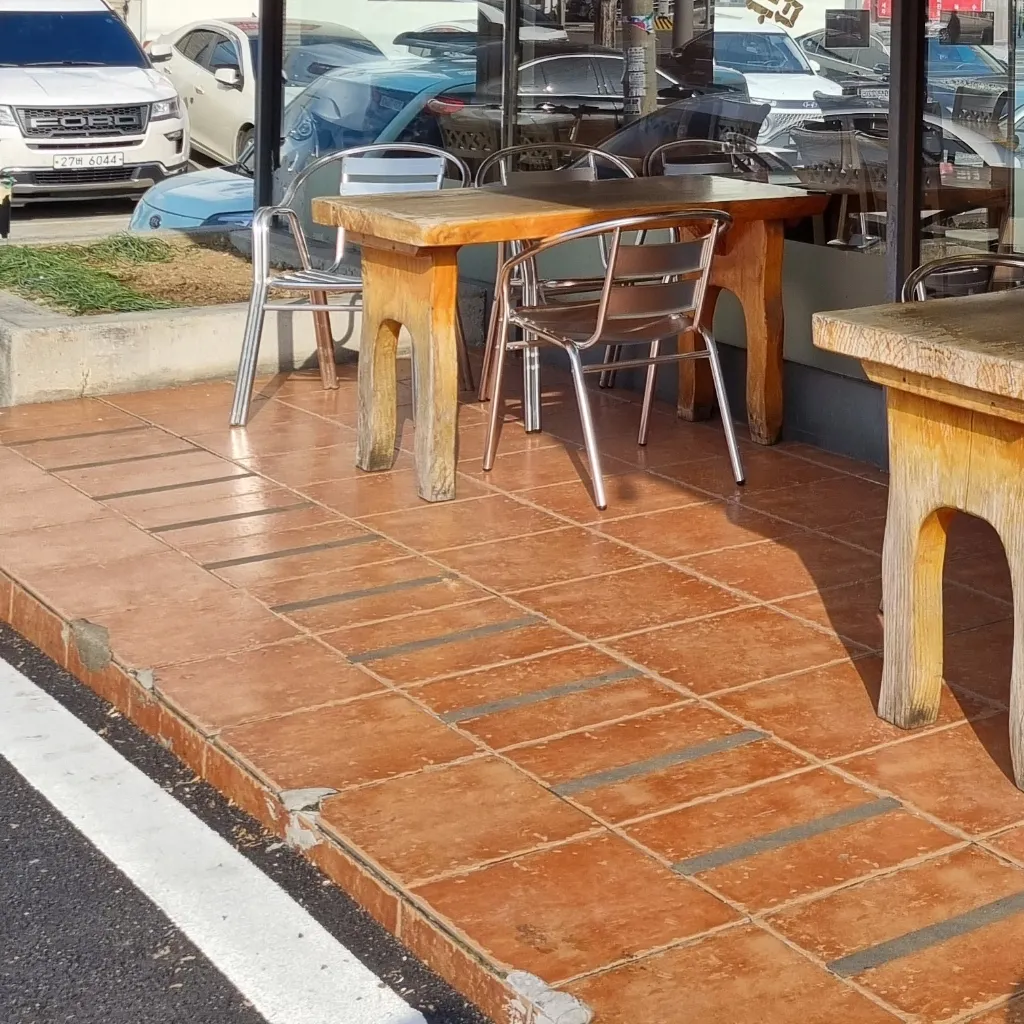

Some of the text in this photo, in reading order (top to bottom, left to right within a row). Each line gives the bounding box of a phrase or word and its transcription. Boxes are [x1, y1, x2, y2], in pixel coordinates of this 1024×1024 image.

[30, 115, 137, 127] FORD
[60, 155, 117, 167] 27버 6044
